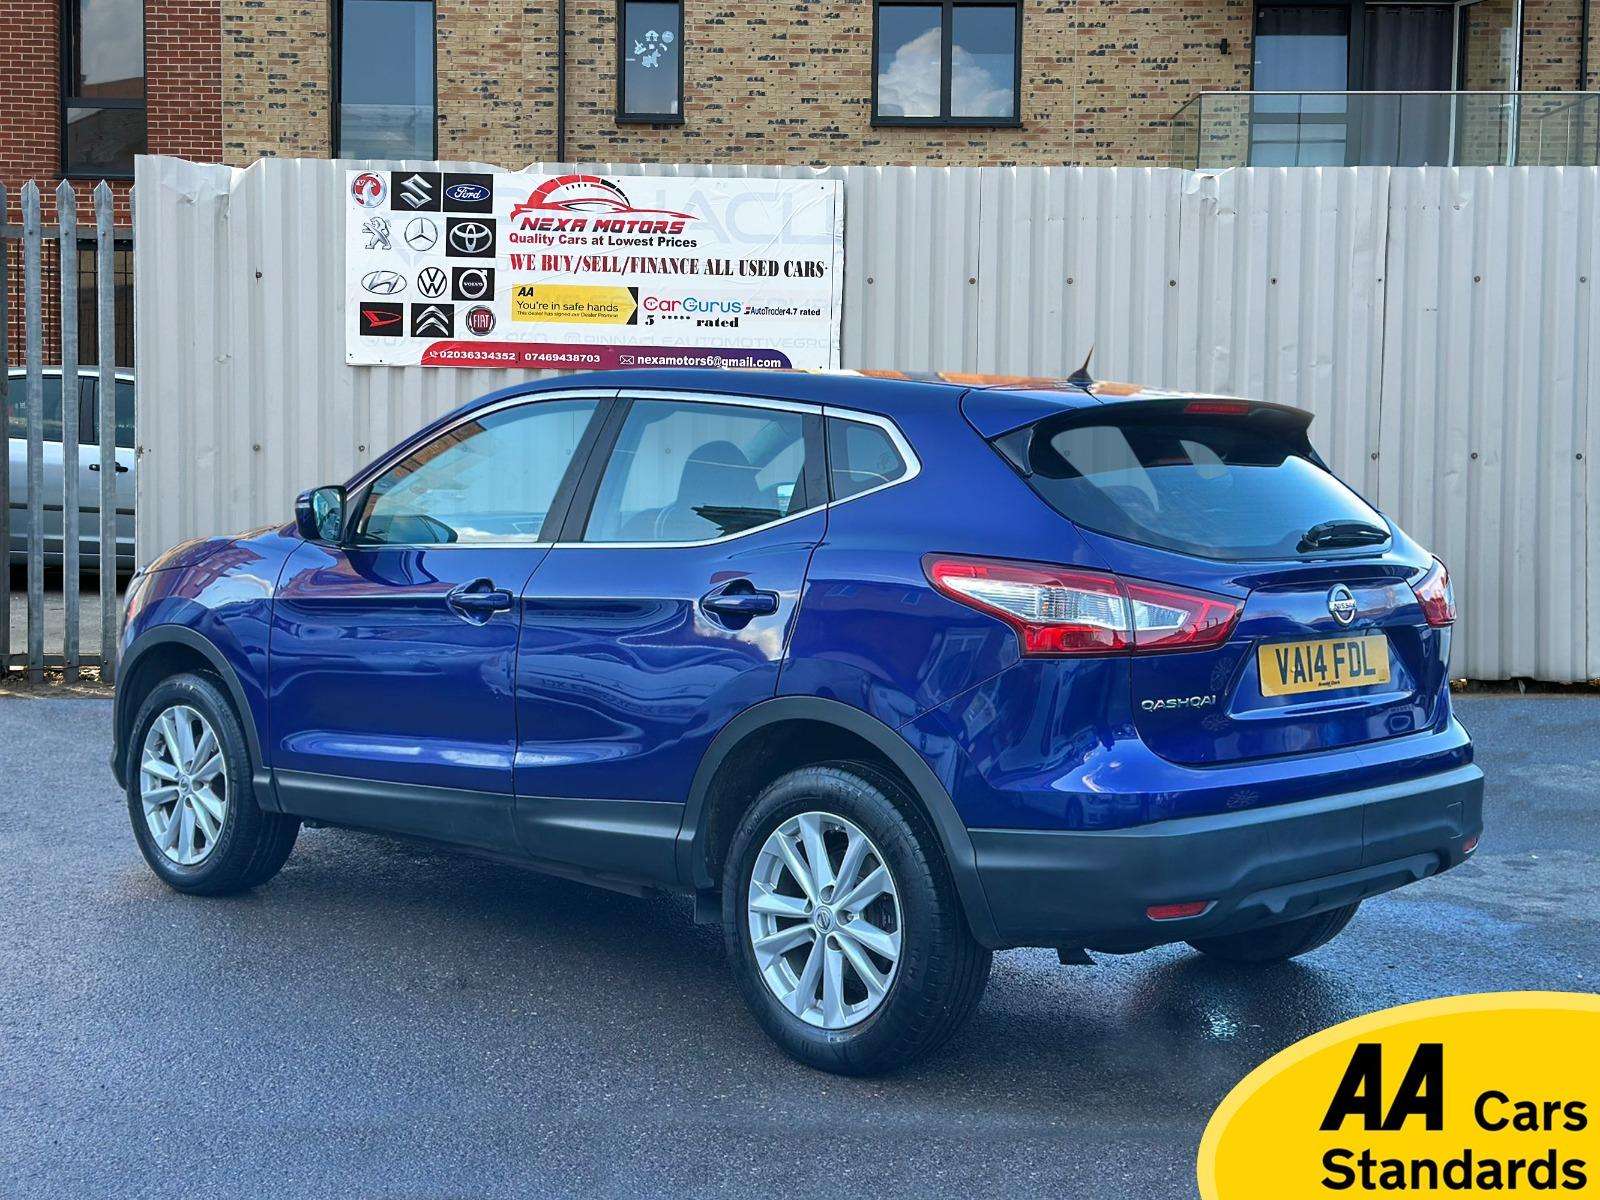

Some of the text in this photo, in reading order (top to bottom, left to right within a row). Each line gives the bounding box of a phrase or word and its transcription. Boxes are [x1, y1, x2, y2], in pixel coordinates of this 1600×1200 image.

[454, 186, 482, 199] Ford
[520, 217, 686, 235] NEXA MOTORS
[509, 233, 698, 248] Quality Cars at Lowest Prices
[509, 253, 825, 278] WE BUY/SELL/FINANCE ALL USED CARS
[517, 286, 534, 297] AA
[516, 300, 619, 313] You're in safe hands
[642, 296, 742, 314] CarGurus
[799, 308, 821, 316] rated
[473, 314, 491, 328] FIAT
[644, 315, 739, 328] 5 rated
[524, 353, 601, 363] 07469438703
[637, 355, 782, 370] nexamotors6@gmail.com
[1275, 641, 1377, 686] VA14 FDL
